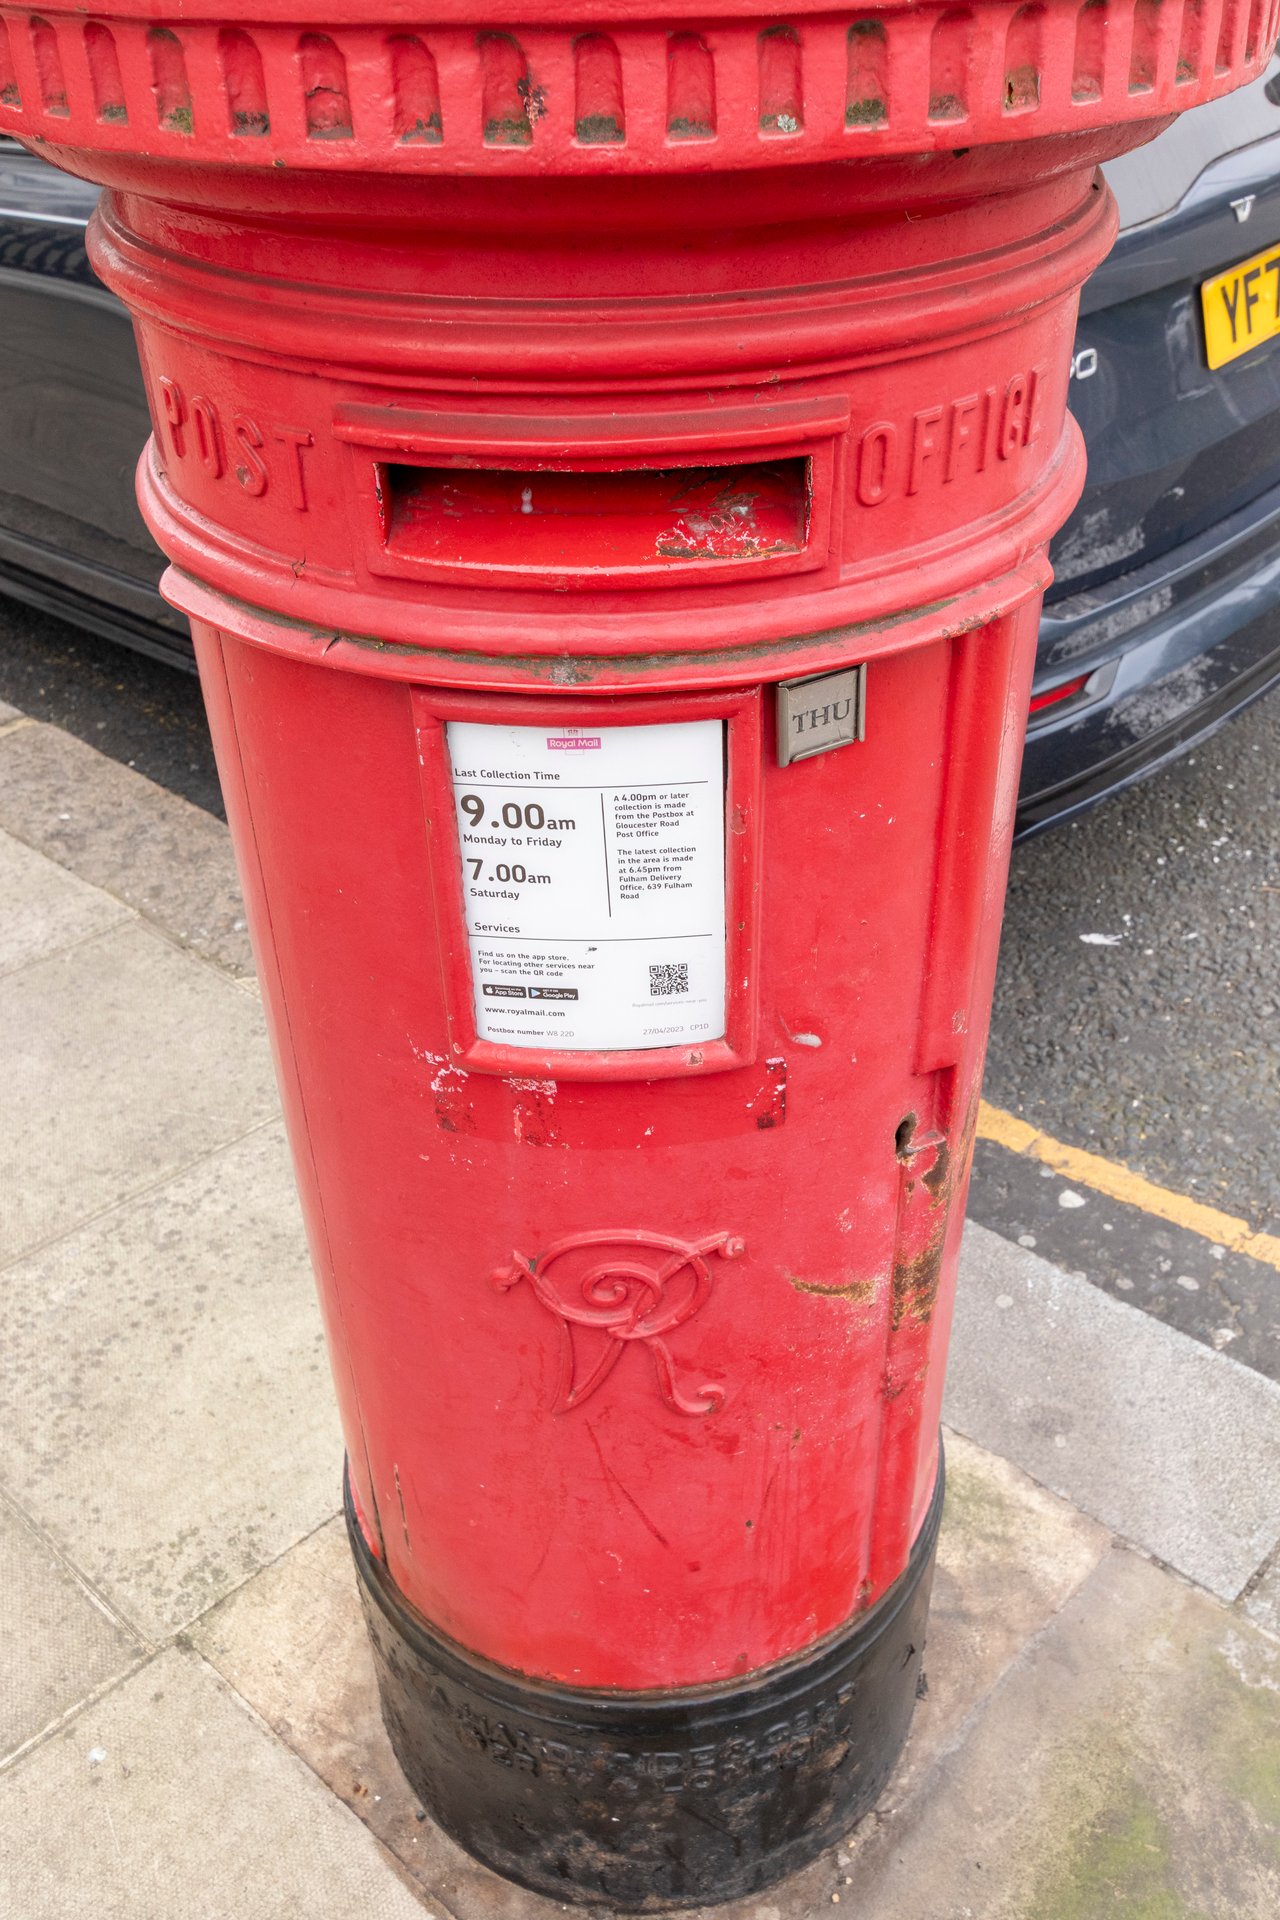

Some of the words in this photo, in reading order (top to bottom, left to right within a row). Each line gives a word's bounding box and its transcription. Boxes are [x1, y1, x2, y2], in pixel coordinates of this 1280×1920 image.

[158, 375, 316, 514] POST
[855, 358, 1053, 508] OFFICE
[792, 698, 852, 734] THU
[550, 739, 576, 749] Royal
[577, 738, 599, 748] Mail
[454, 768, 478, 778] Last
[480, 769, 531, 780] Collection
[533, 771, 561, 781] Time
[621, 793, 657, 802] 4.00pm
[670, 792, 690, 800] later
[614, 803, 653, 811] collection
[664, 801, 686, 809] made
[460, 794, 576, 831] 9.00am
[636, 812, 650, 820] the
[652, 810, 684, 819] Postbox
[615, 821, 657, 829] Gloucester
[659, 820, 680, 828] Road
[636, 829, 659, 838] Office
[463, 834, 507, 847] Monday
[511, 836, 523, 845] to
[526, 837, 562, 848] Friday
[659, 846, 697, 854] collection
[672, 854, 694, 863] made
[466, 858, 552, 884] 7.00am
[629, 866, 661, 875] 6.45pm
[619, 875, 648, 883] Fulham
[650, 873, 682, 882] Delivery
[664, 881, 693, 889] Fulham
[470, 888, 520, 900] Saturday
[473, 922, 521, 934] Services
[492, 959, 522, 968] locating
[485, 1006, 566, 1018] www.royalmail.com
[487, 1026, 515, 1034] Postbox
